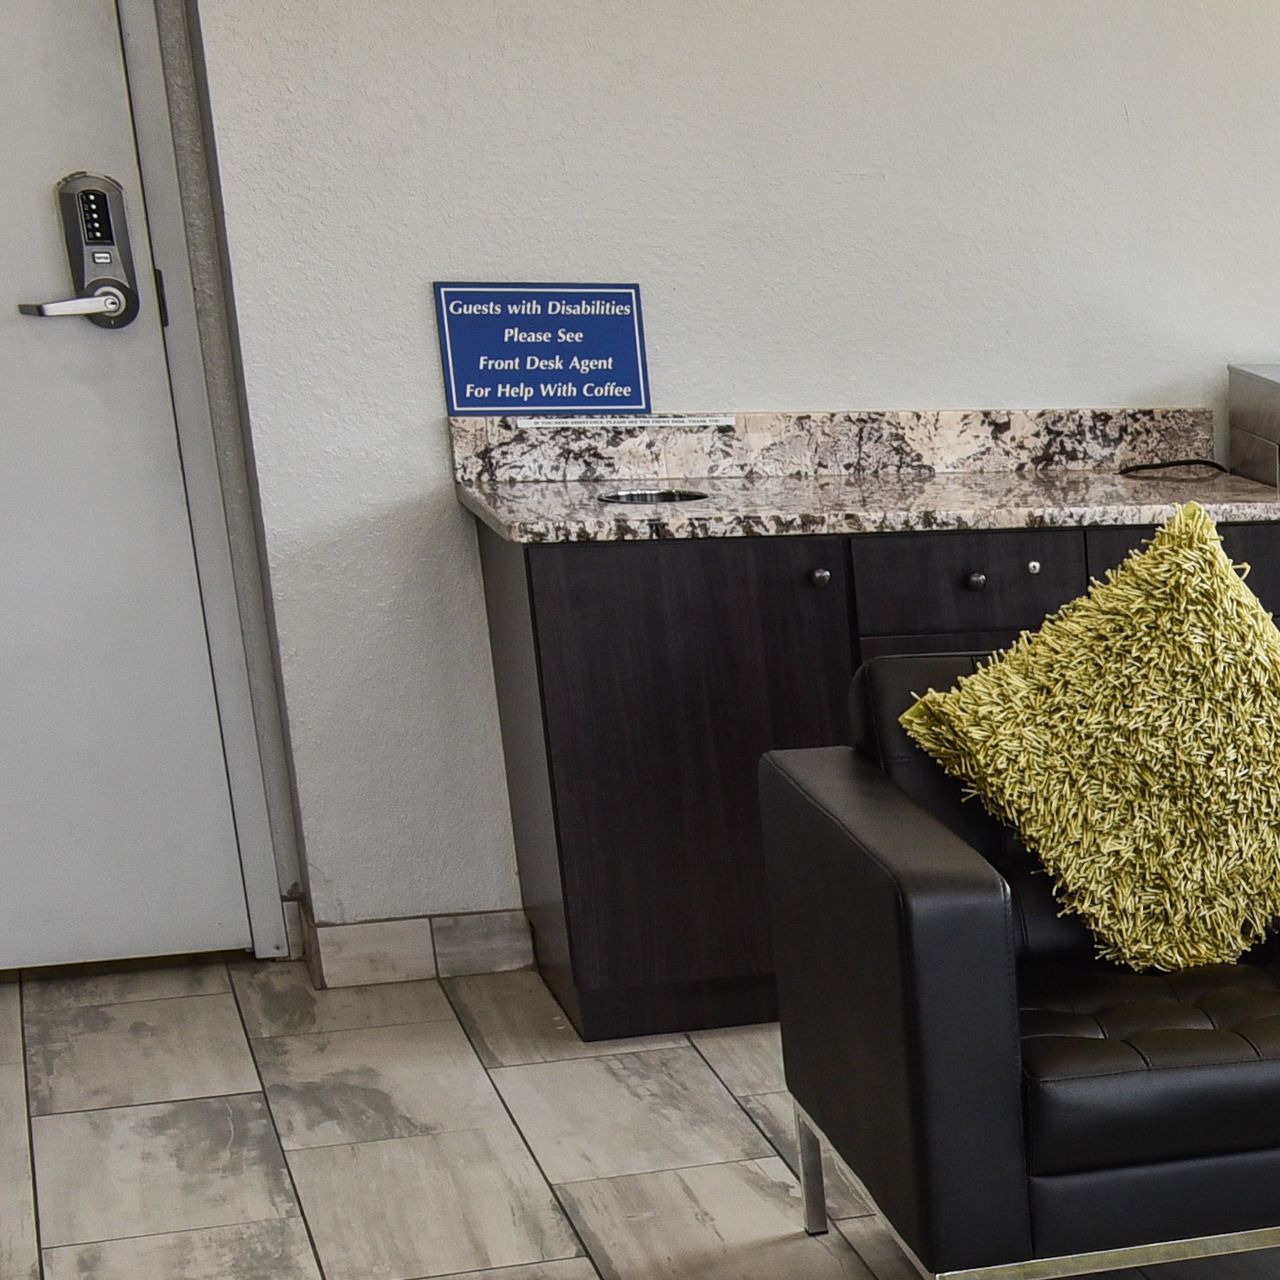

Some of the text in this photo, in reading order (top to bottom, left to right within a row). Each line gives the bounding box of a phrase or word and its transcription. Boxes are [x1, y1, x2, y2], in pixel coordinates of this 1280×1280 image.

[448, 300, 631, 316] Guests with Disabilities
[503, 328, 584, 343] Please See
[478, 355, 613, 374] Front Desk Agent
[465, 382, 632, 401] For Help With Coffee
